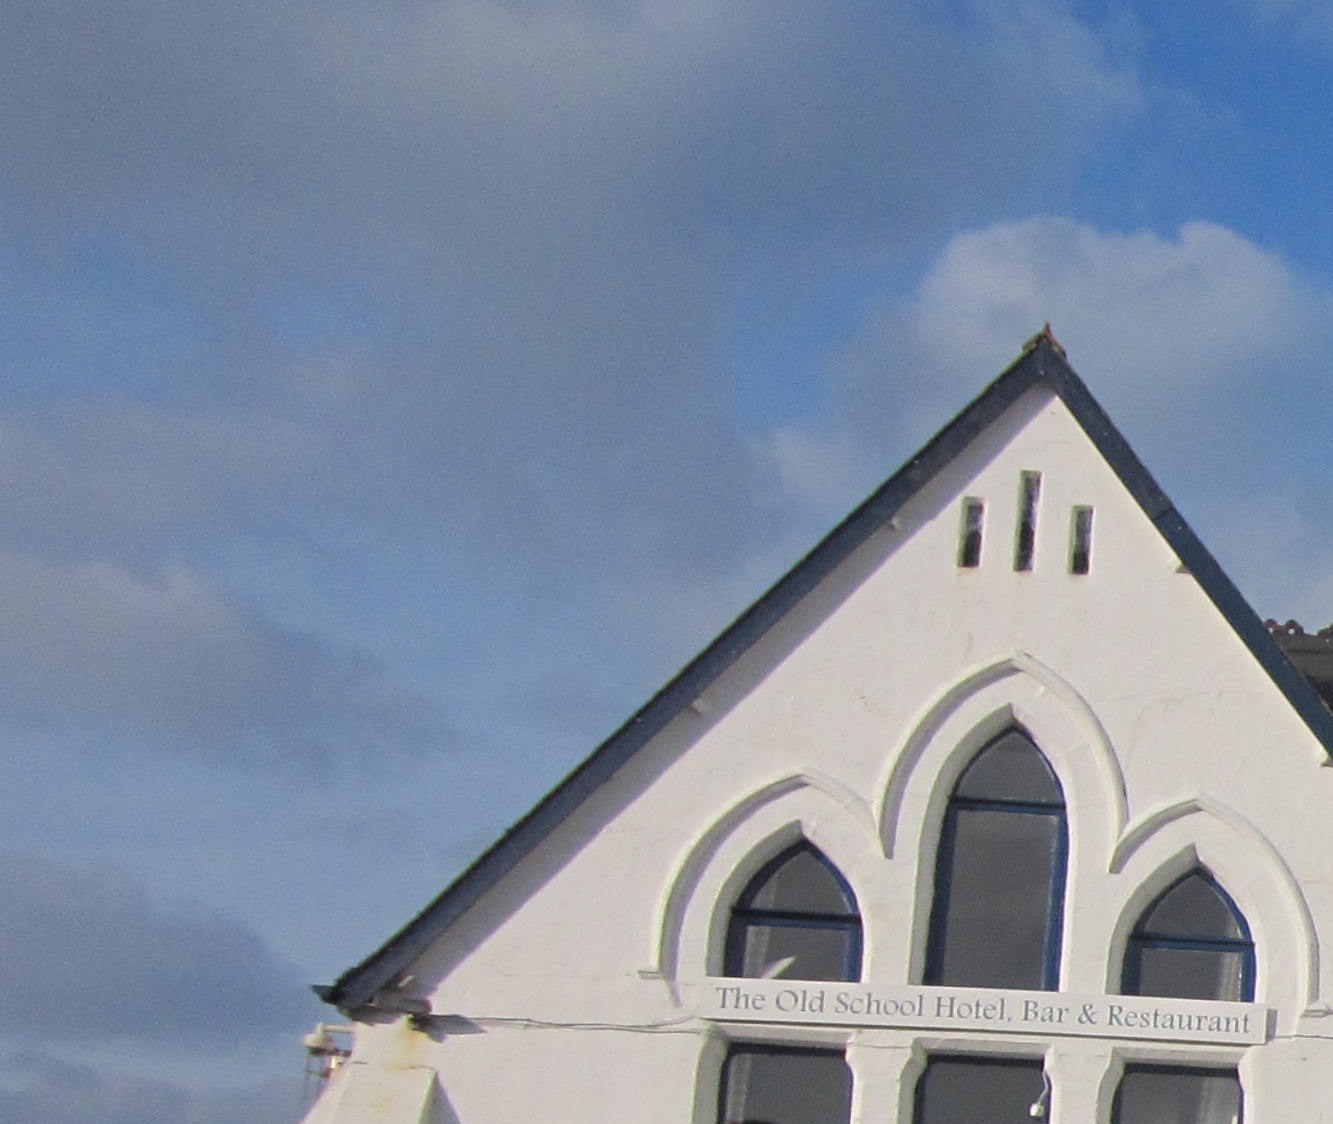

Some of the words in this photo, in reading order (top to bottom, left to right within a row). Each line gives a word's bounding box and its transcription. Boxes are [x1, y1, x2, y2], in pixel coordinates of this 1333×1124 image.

[715, 987, 766, 1011] The
[775, 990, 825, 1013] Old
[834, 992, 924, 1018] School
[934, 995, 1012, 1023] Hotel,
[1023, 999, 1069, 1024] Bar
[1077, 1003, 1098, 1025] &
[1107, 1004, 1250, 1034] Restaurant
